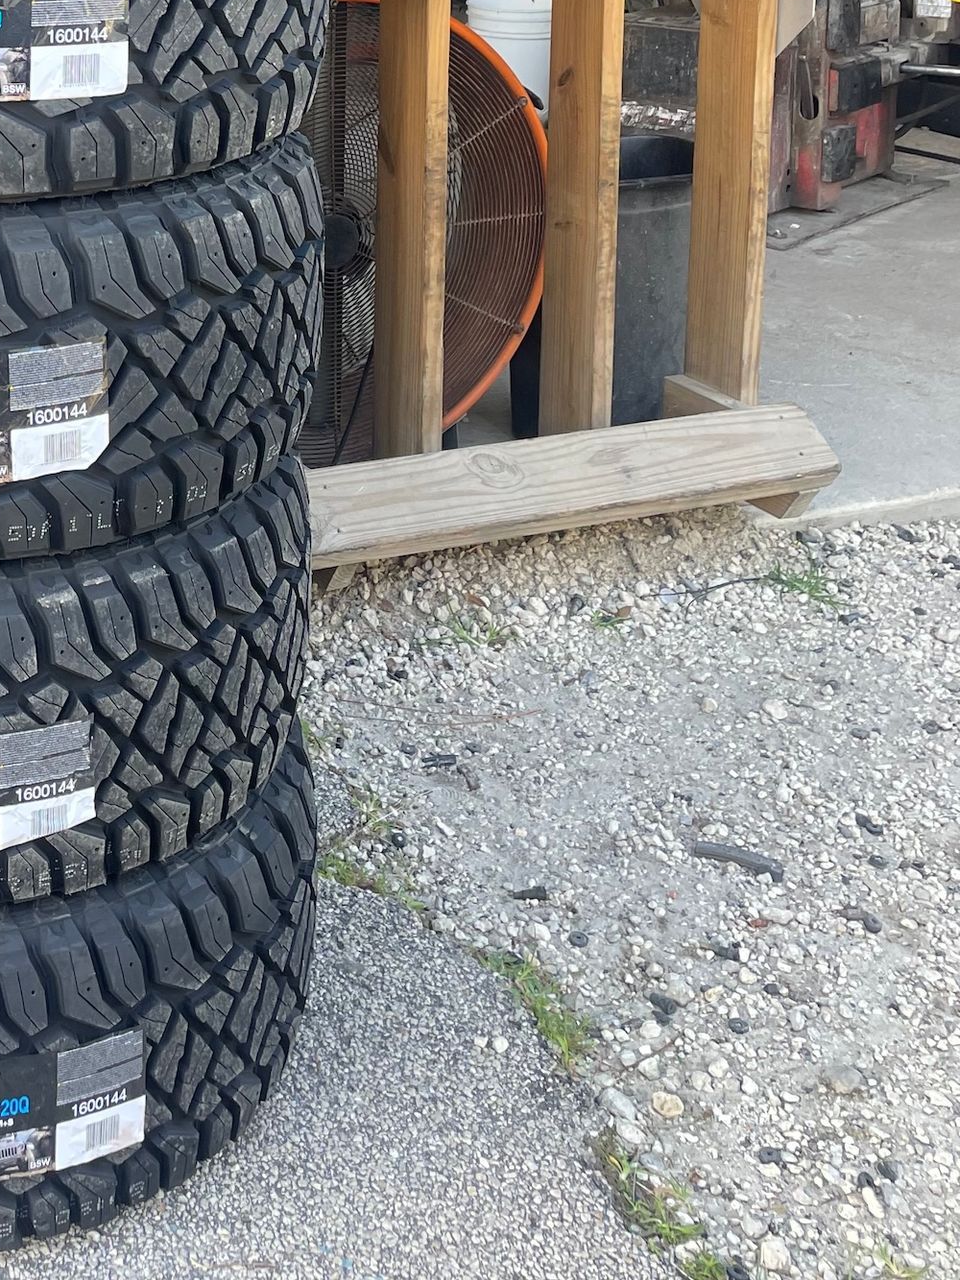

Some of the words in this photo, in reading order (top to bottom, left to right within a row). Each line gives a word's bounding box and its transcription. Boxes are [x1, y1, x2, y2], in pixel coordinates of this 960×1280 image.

[46, 26, 109, 44] 1600144
[1, 83, 26, 94] BSW
[26, 402, 88, 426] 1600144
[15, 778, 76, 802] 1600144
[71, 1087, 128, 1118] 1600144
[29, 1157, 51, 1170] BSW
